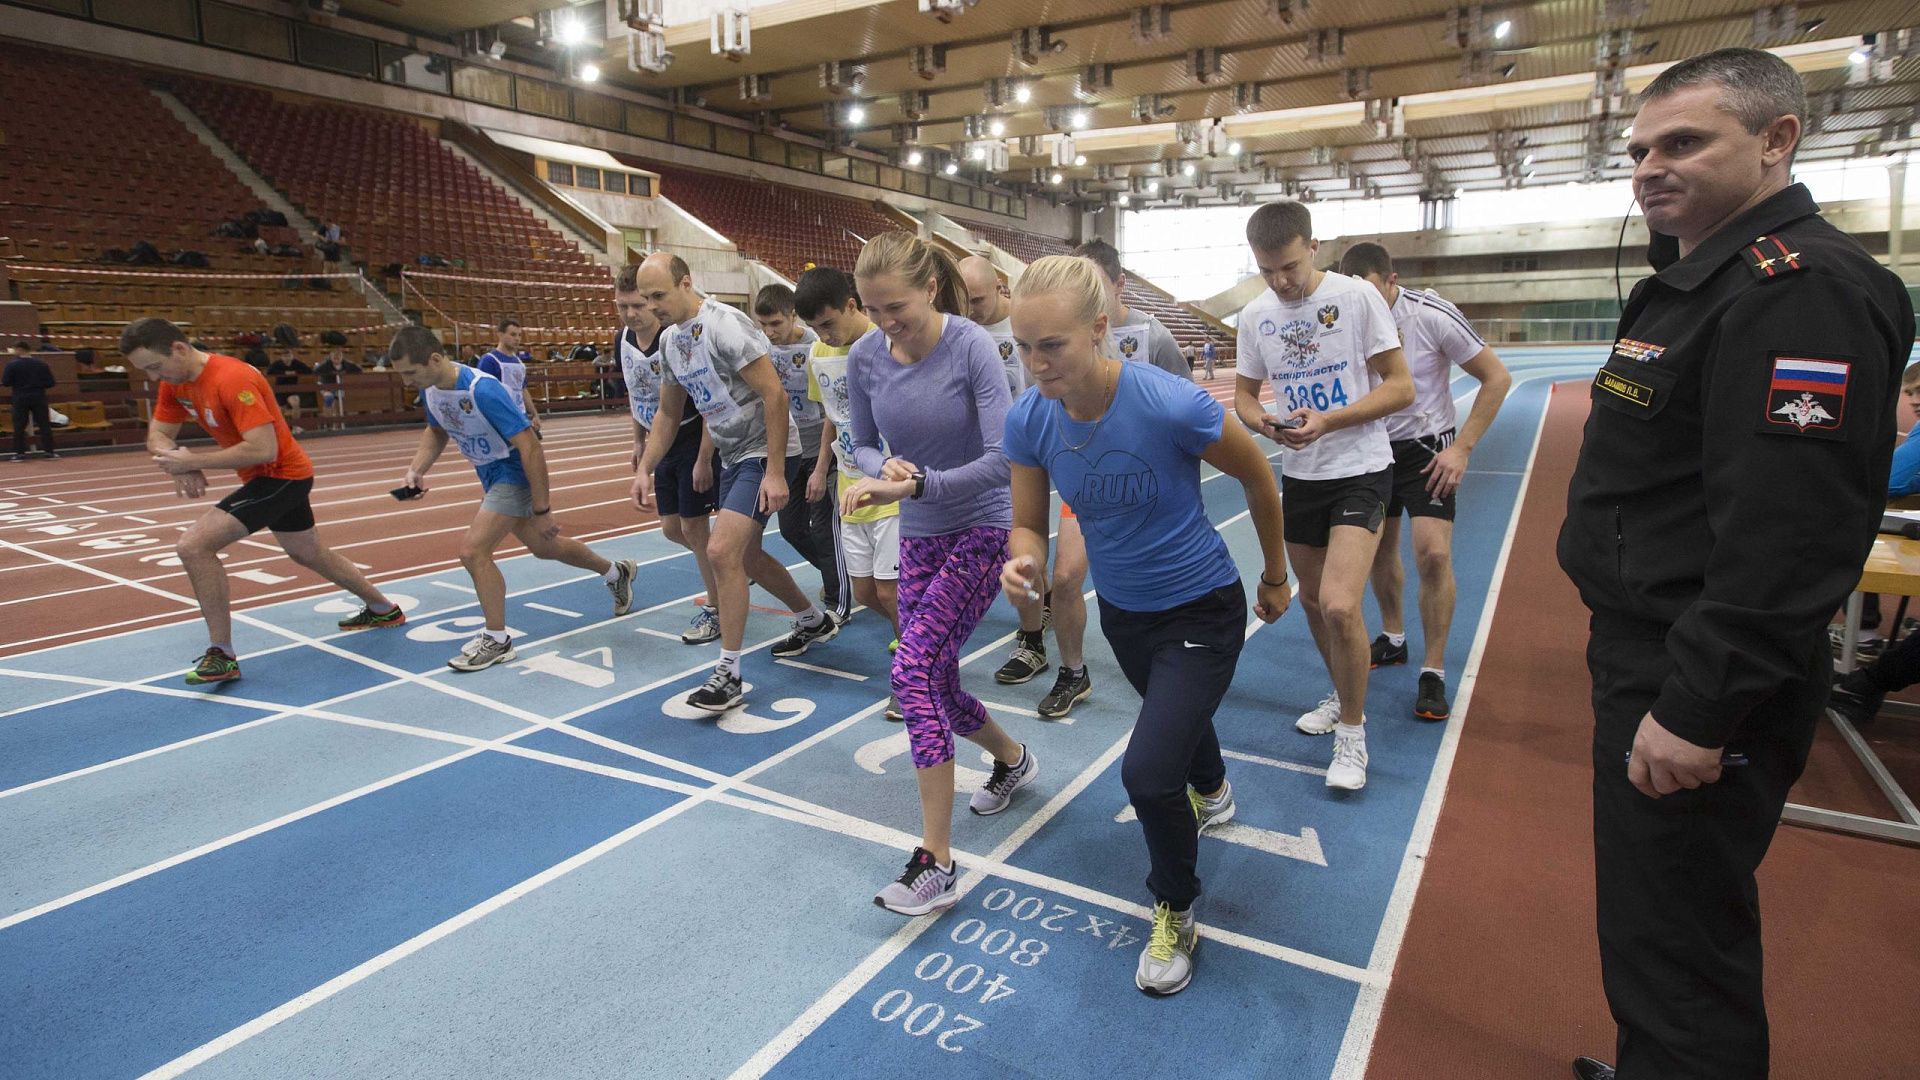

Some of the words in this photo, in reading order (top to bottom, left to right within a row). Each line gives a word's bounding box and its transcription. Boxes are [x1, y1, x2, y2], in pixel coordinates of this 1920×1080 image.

[1283, 377, 1348, 412] 3864
[1081, 470, 1152, 506] RUN
[505, 646, 616, 688] 4
[950, 917, 1050, 967] 800
[914, 951, 1017, 1004] 400
[871, 988, 985, 1053] 200
